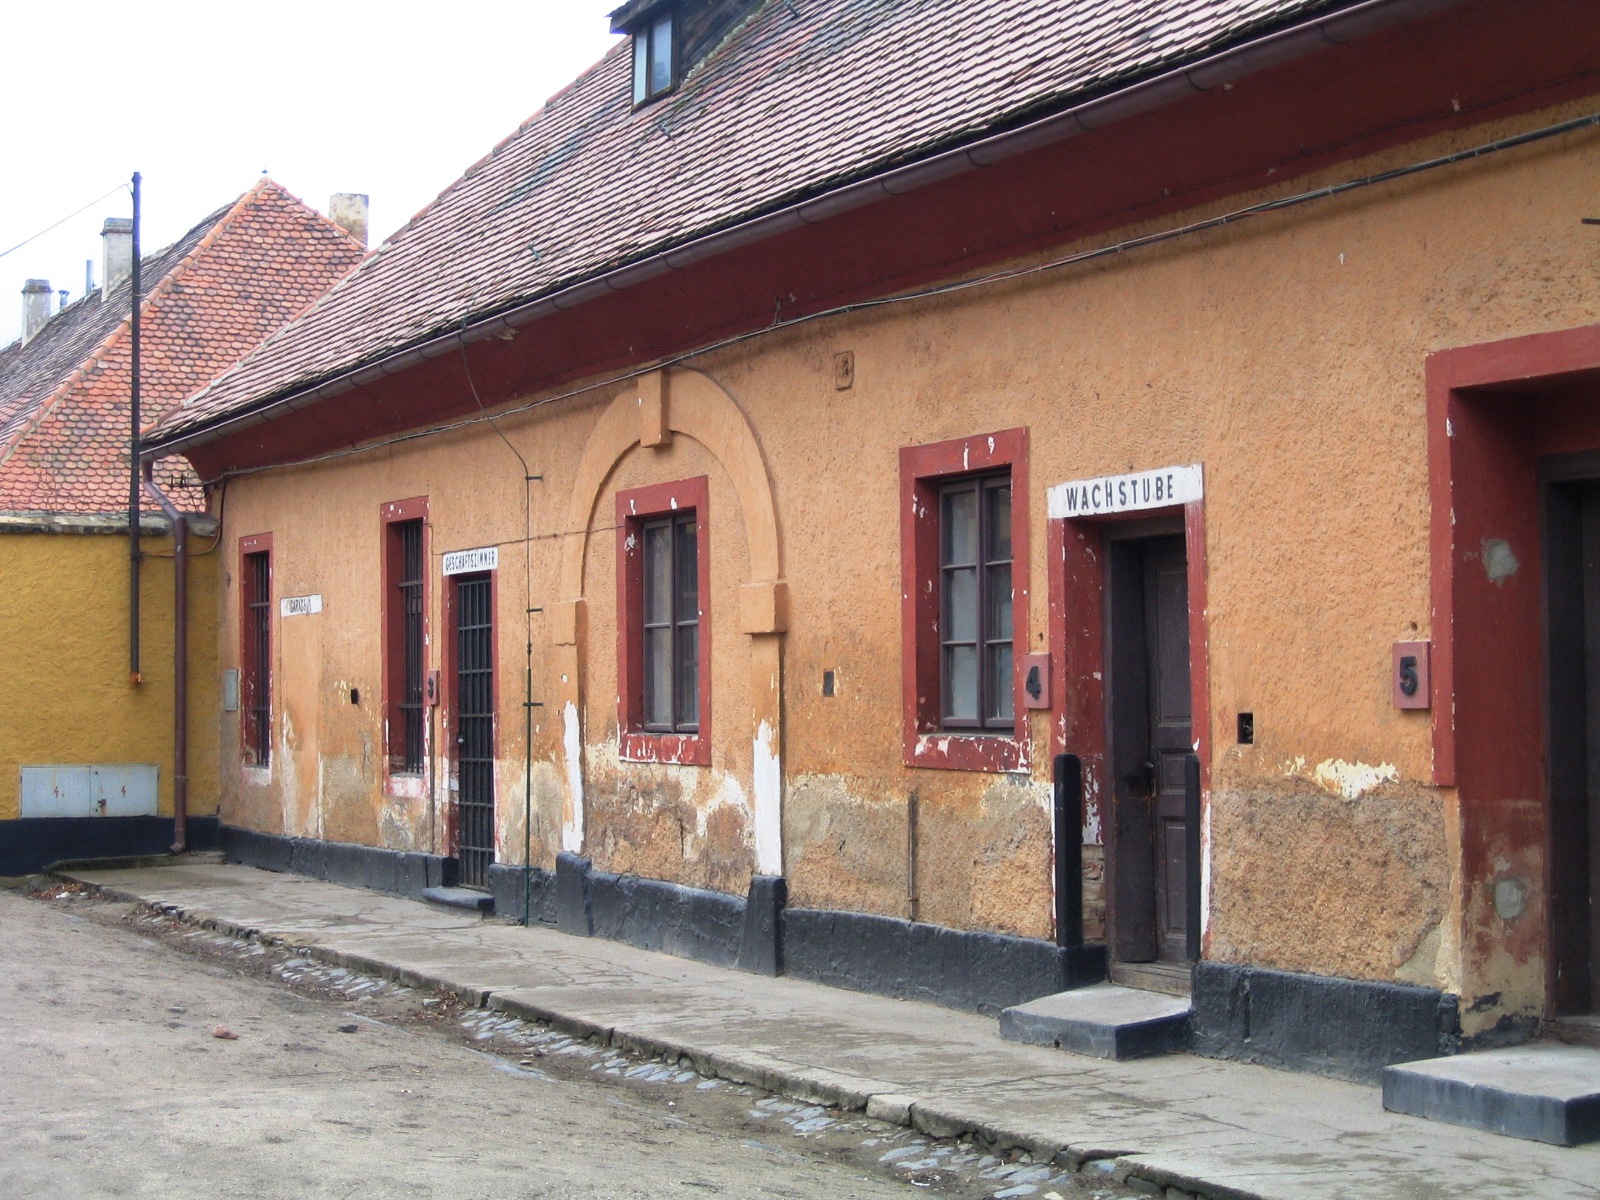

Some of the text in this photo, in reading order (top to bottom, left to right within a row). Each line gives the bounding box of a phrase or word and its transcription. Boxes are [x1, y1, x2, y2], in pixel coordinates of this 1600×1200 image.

[1066, 474, 1174, 512] WACHSTUBE
[1026, 665, 1042, 700] 4
[1399, 655, 1418, 696] 5
